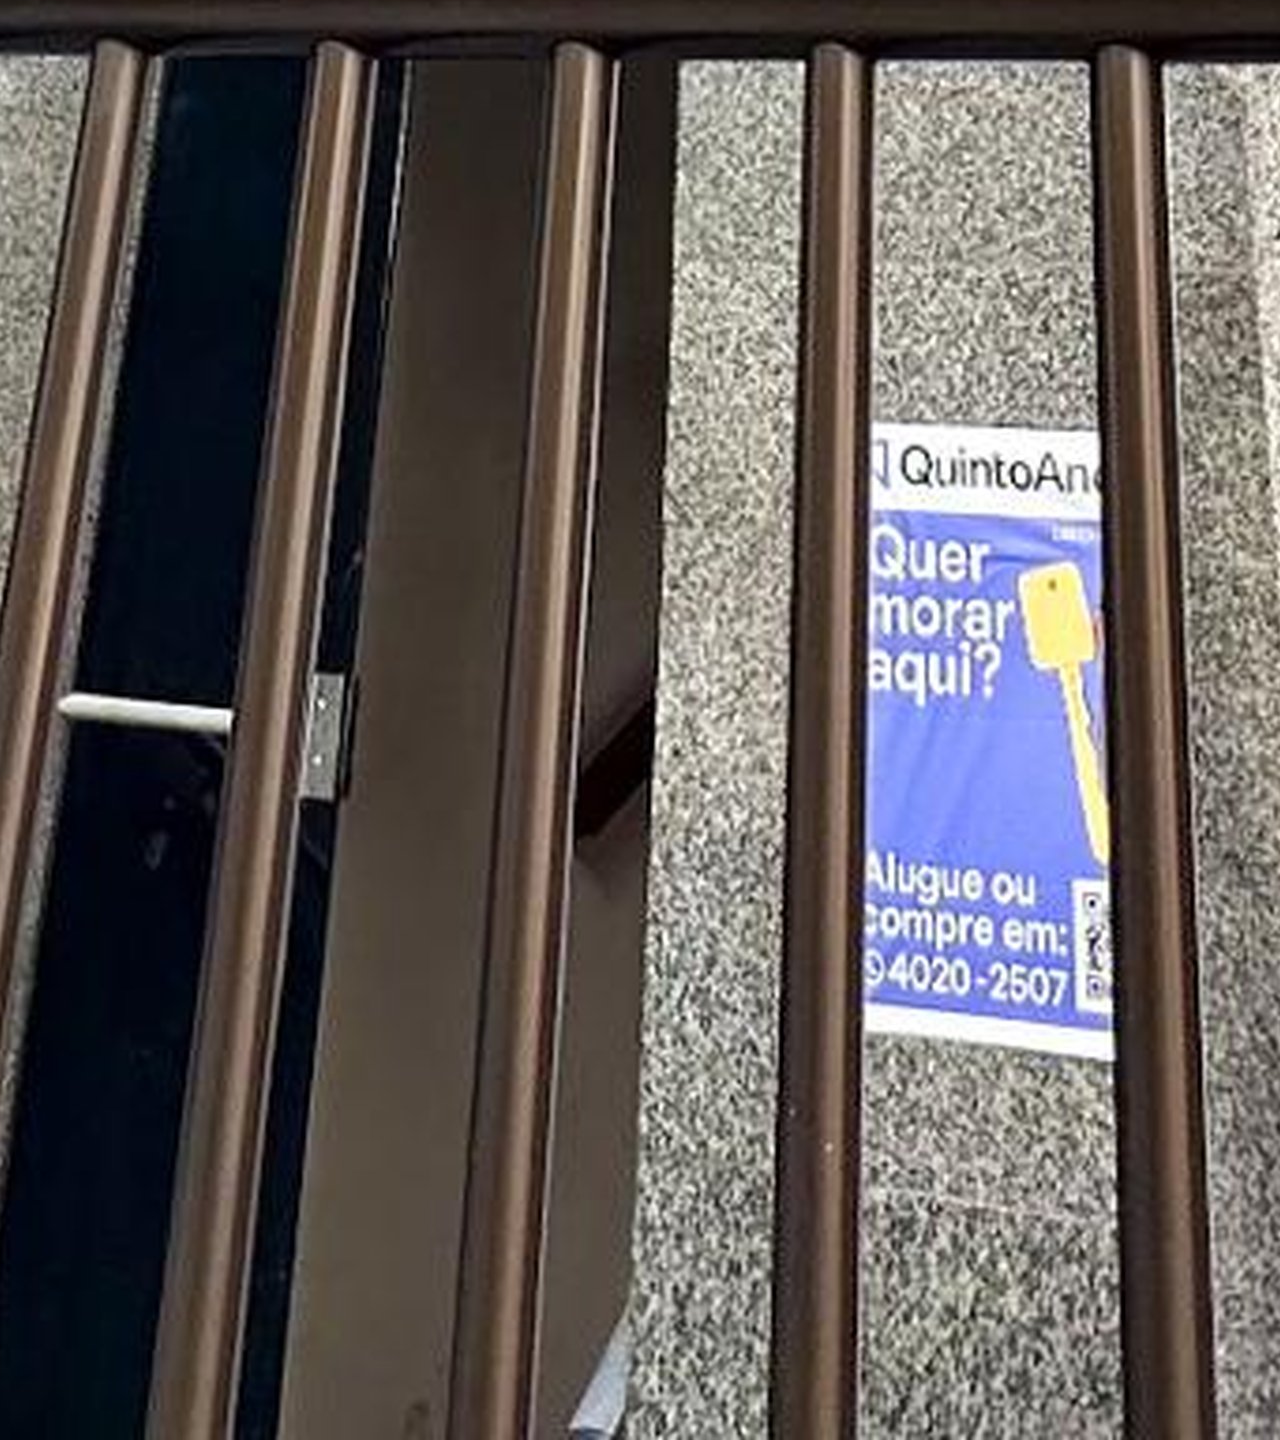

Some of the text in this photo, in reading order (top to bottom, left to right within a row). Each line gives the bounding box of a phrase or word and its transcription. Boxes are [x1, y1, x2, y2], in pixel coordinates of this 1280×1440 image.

[901, 444, 1101, 493] QuintoAn
[872, 526, 991, 584] Quer
[871, 590, 1016, 641] morar
[870, 641, 1002, 708] aqui?
[867, 850, 1037, 907] Alugue ou
[1002, 916, 1069, 958] em:
[888, 952, 1069, 1008] 4020-2507
